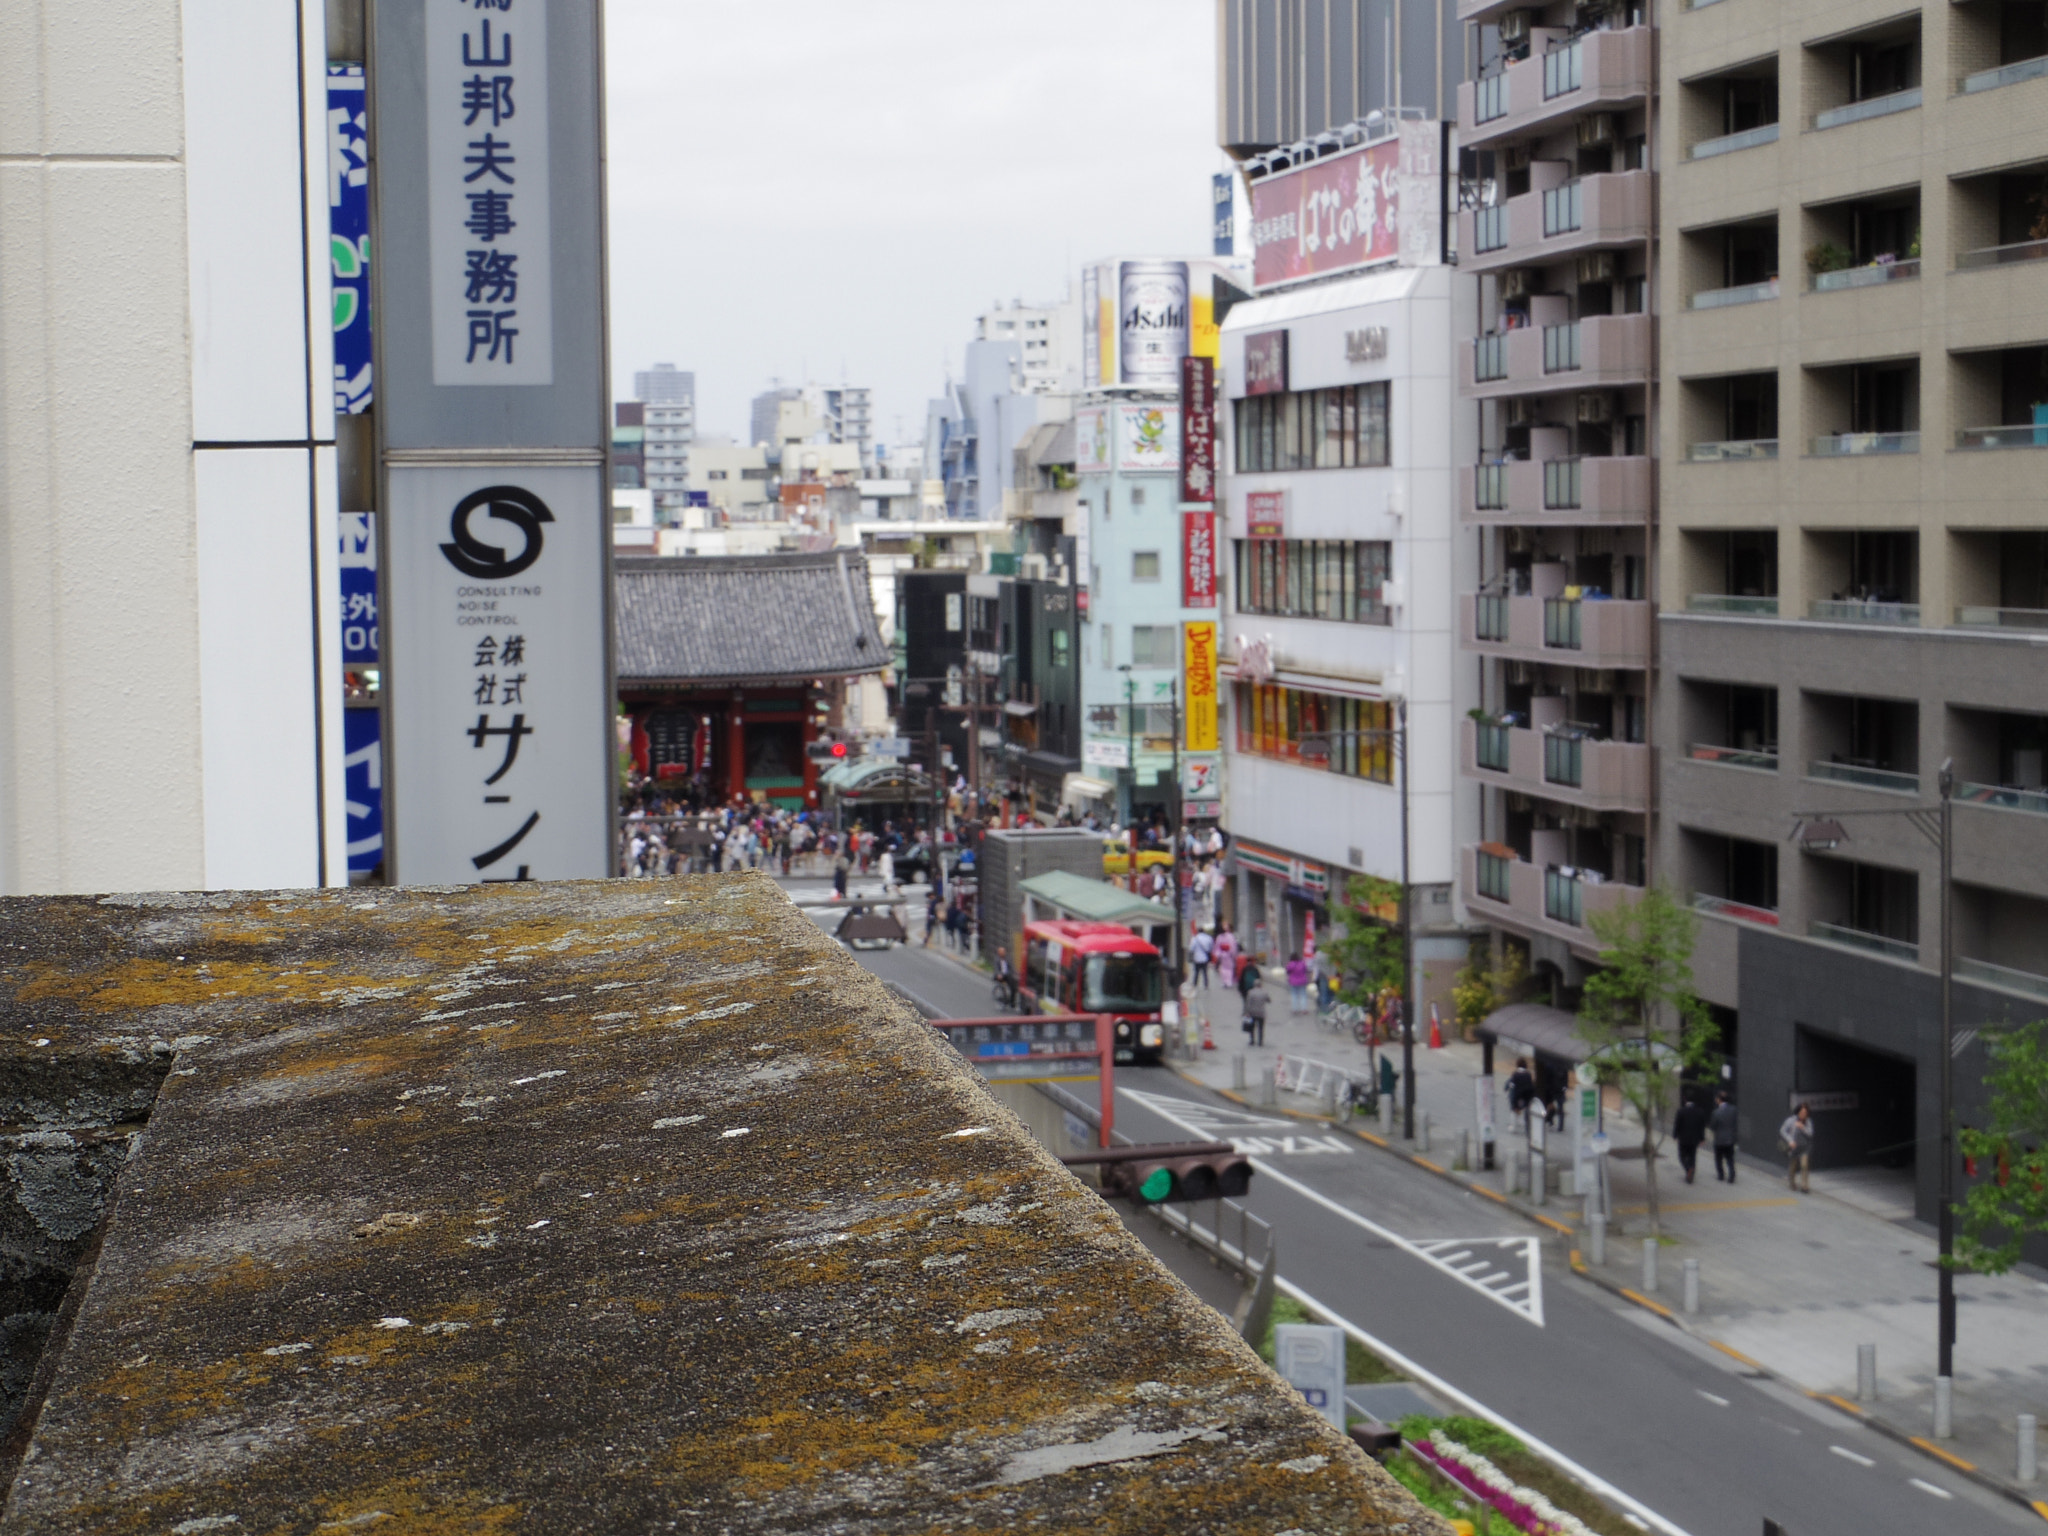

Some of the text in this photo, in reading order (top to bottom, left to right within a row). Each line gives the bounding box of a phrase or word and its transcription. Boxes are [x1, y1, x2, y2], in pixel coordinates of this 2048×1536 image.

[1123, 304, 1185, 330] Asahi
[457, 586, 542, 598] CONSULTING
[457, 601, 498, 612] NOISE
[457, 615, 519, 626] CONTROL
[1187, 626, 1215, 697] Denny's
